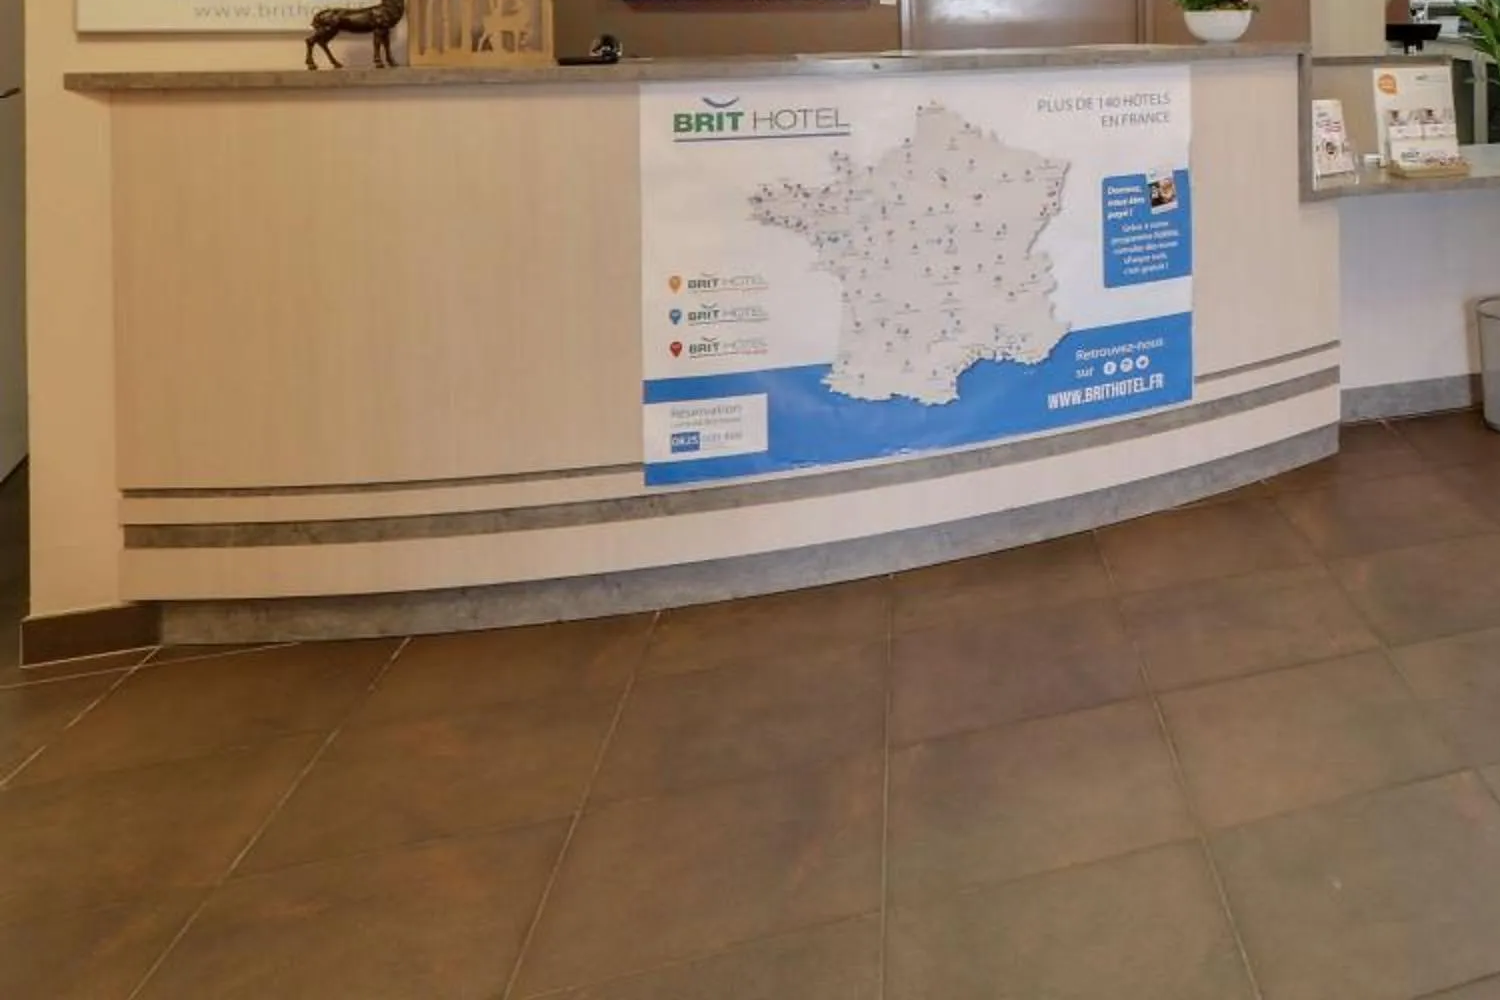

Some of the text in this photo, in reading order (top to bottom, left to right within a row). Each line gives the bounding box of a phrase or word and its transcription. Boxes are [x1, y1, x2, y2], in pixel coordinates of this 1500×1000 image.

[1037, 96, 1074, 113] PLUS
[1075, 96, 1095, 111] DE
[673, 108, 852, 133] BRIT HOTEL
[1101, 111, 1170, 128] EN FRANCE
[1046, 372, 1166, 410] WWW.BRITHOTEL.FR
